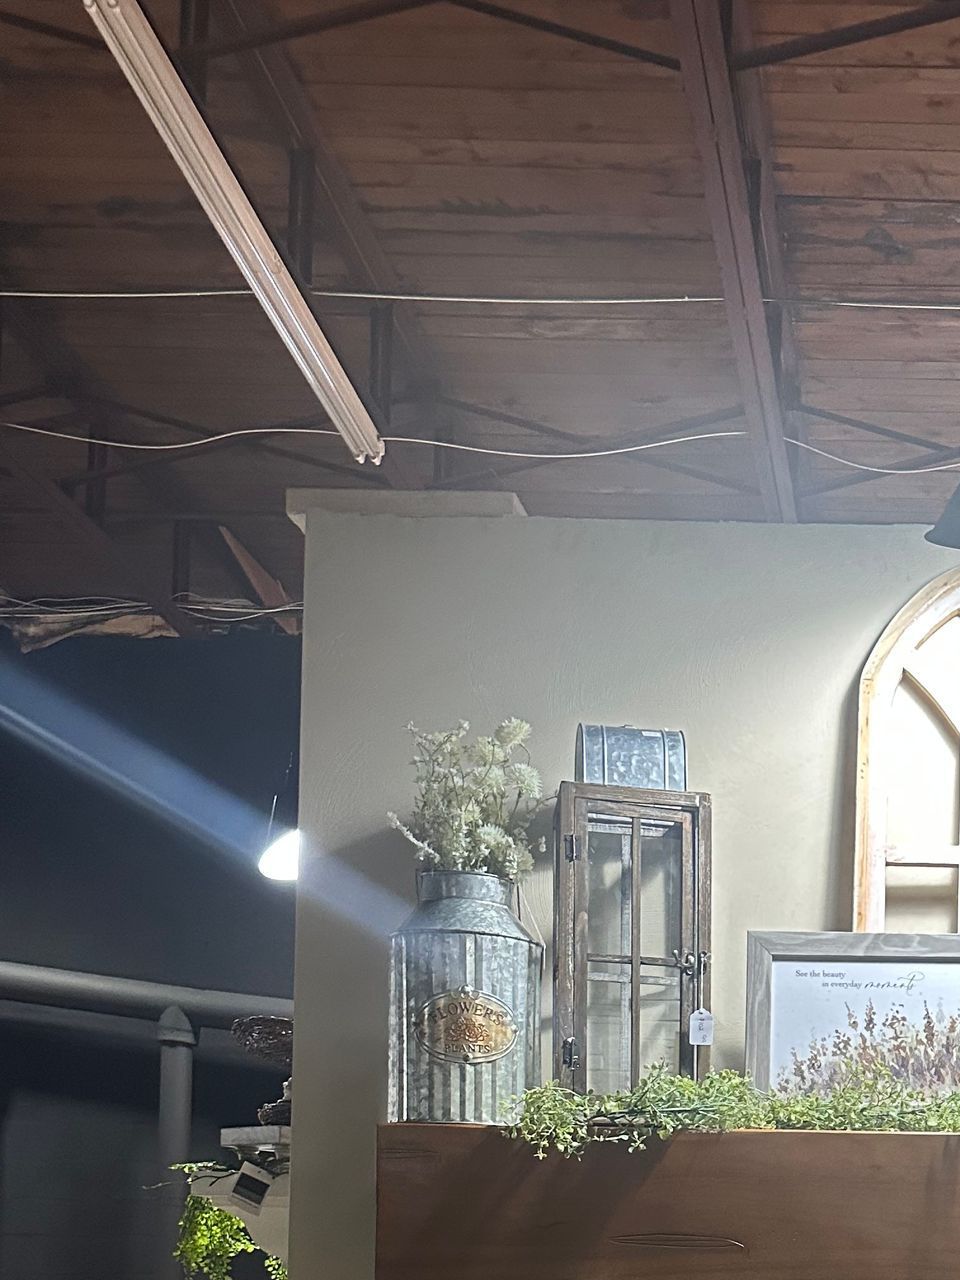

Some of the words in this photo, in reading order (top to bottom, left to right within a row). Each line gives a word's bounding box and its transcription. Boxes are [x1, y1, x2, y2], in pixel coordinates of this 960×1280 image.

[795, 970, 808, 978] See
[809, 970, 821, 978] the
[822, 970, 847, 979] beauty
[830, 980, 863, 989] everyday
[444, 1044, 492, 1053] PLANTS
